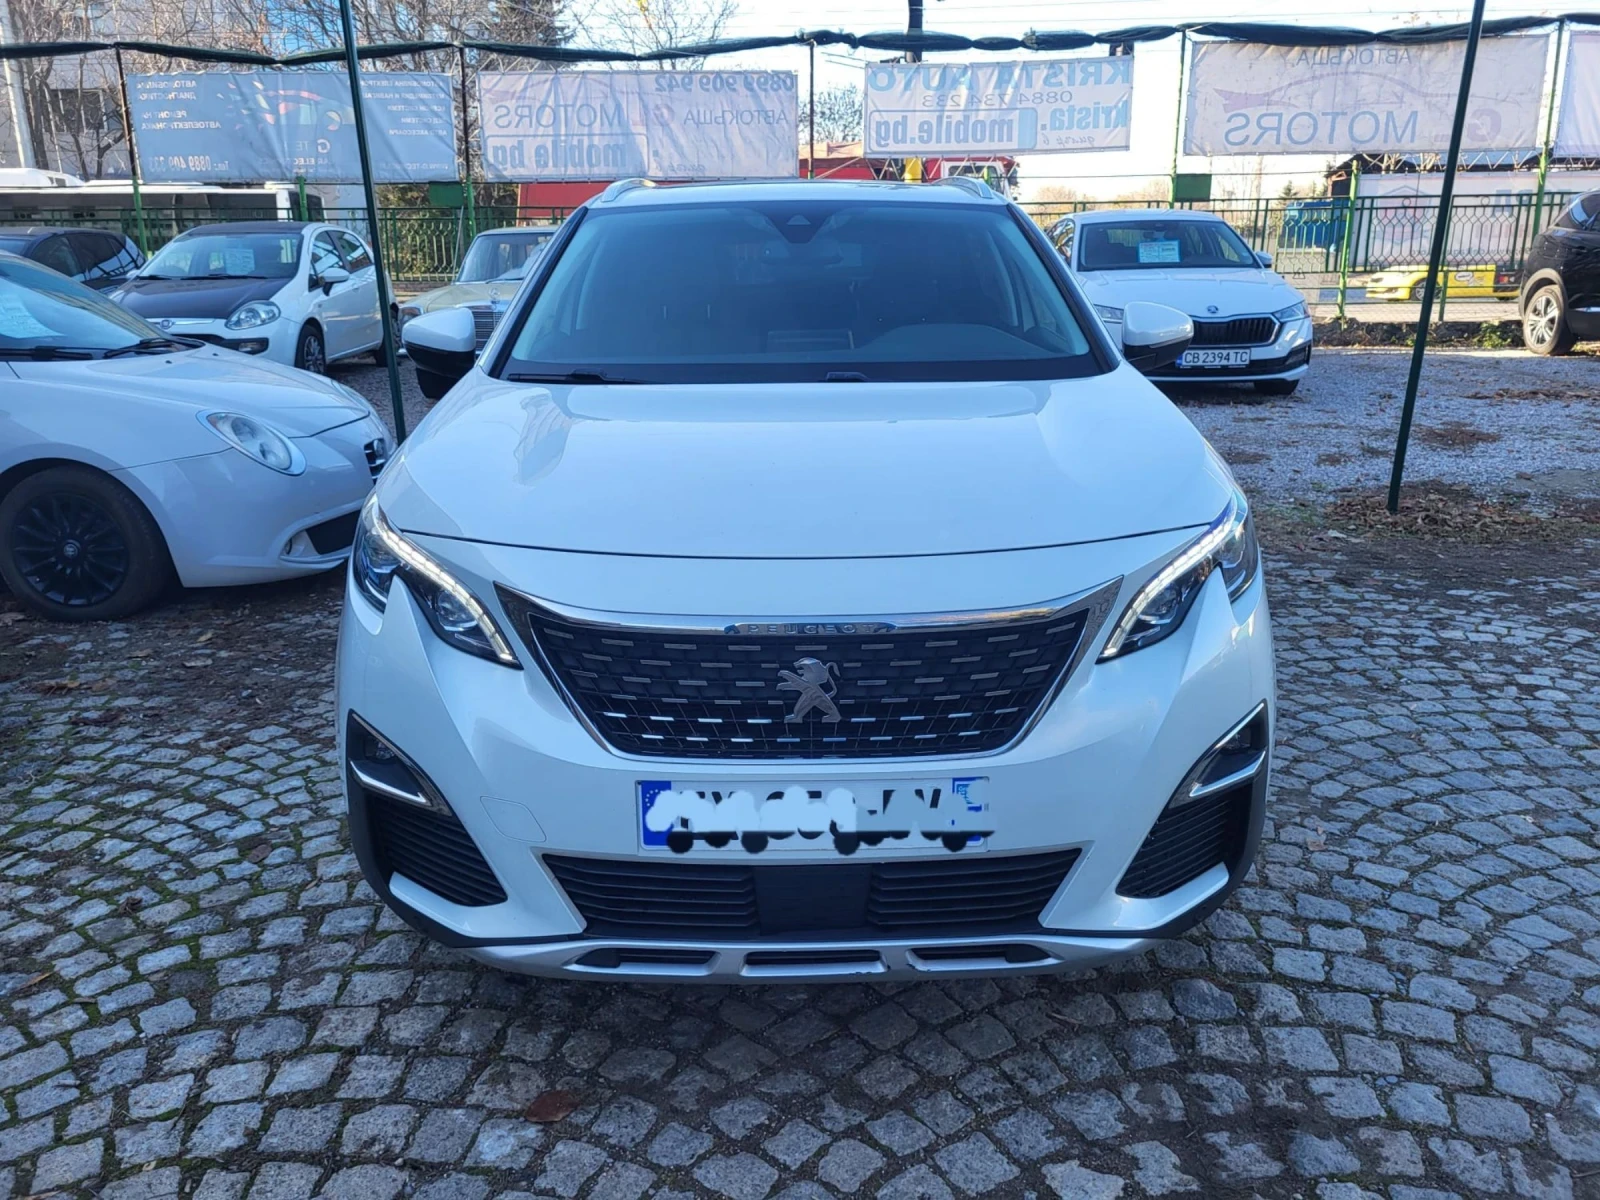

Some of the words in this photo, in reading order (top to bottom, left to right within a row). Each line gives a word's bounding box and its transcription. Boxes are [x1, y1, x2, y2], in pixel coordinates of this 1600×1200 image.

[1184, 352, 1200, 364] CB
[1202, 351, 1230, 363] 2394
[1233, 351, 1248, 363] TC
[748, 623, 874, 634] PEUGEOT
